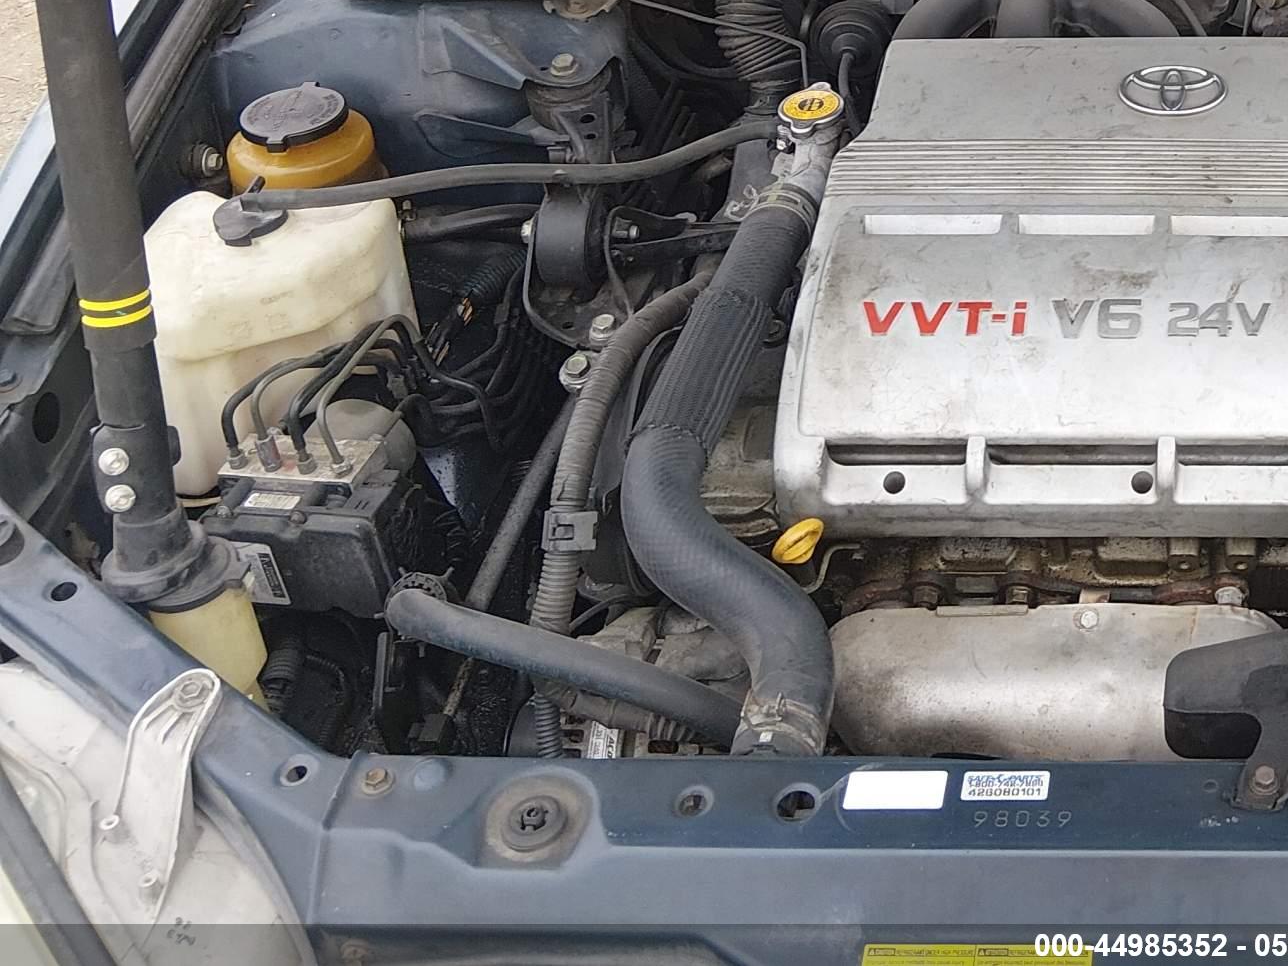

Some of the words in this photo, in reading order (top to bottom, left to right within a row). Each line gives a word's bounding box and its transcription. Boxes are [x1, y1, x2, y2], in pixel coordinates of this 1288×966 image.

[864, 302, 1028, 336] VVT-i
[1051, 299, 1142, 339] V6
[1168, 302, 1270, 337] 24V
[974, 810, 1072, 828] 98039
